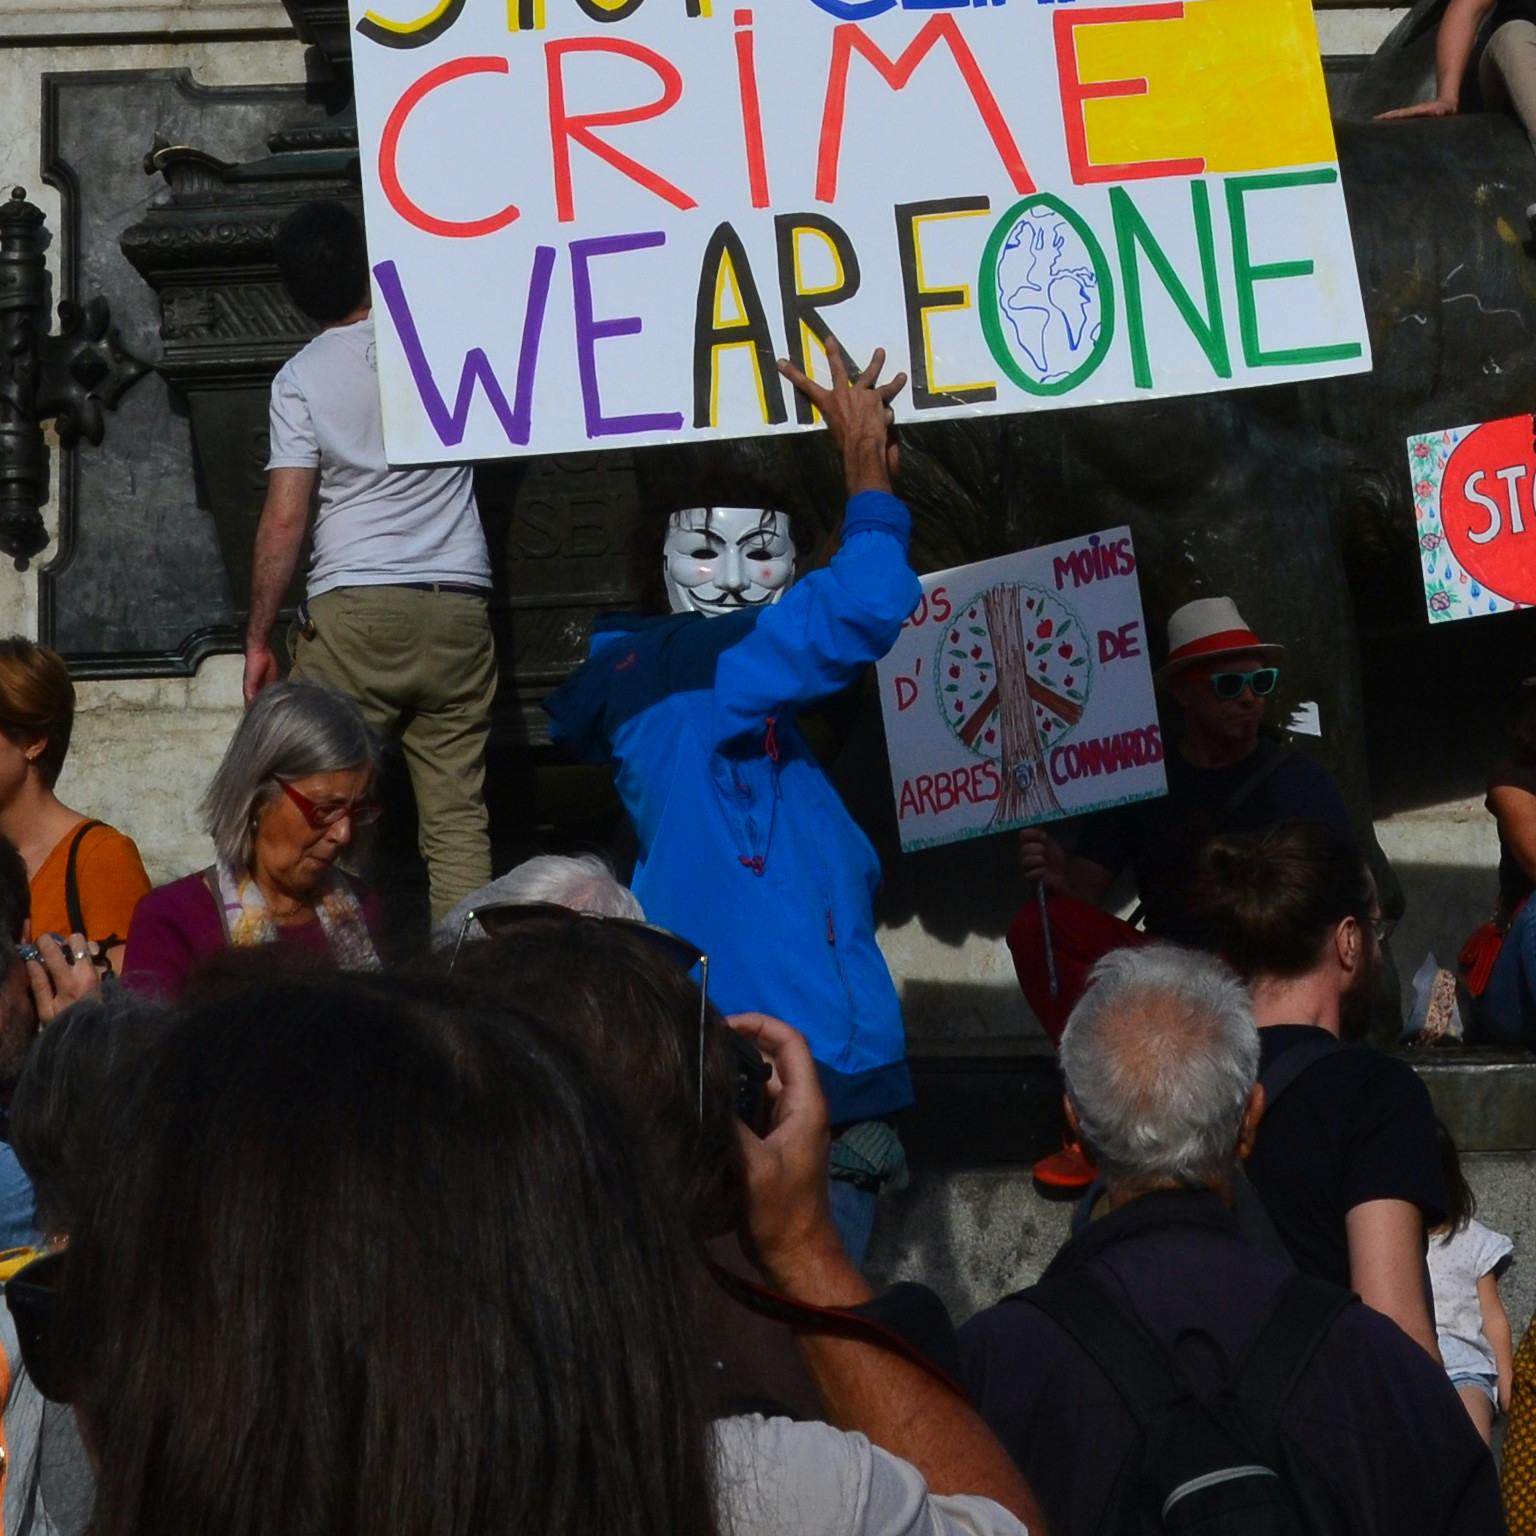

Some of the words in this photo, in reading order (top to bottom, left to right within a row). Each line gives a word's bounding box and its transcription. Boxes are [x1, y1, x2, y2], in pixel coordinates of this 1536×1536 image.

[1097, 621, 1141, 664] DE
[895, 658, 922, 711] D'
[1049, 724, 1164, 787] CONNARDS
[898, 759, 1002, 820] ARBRES
